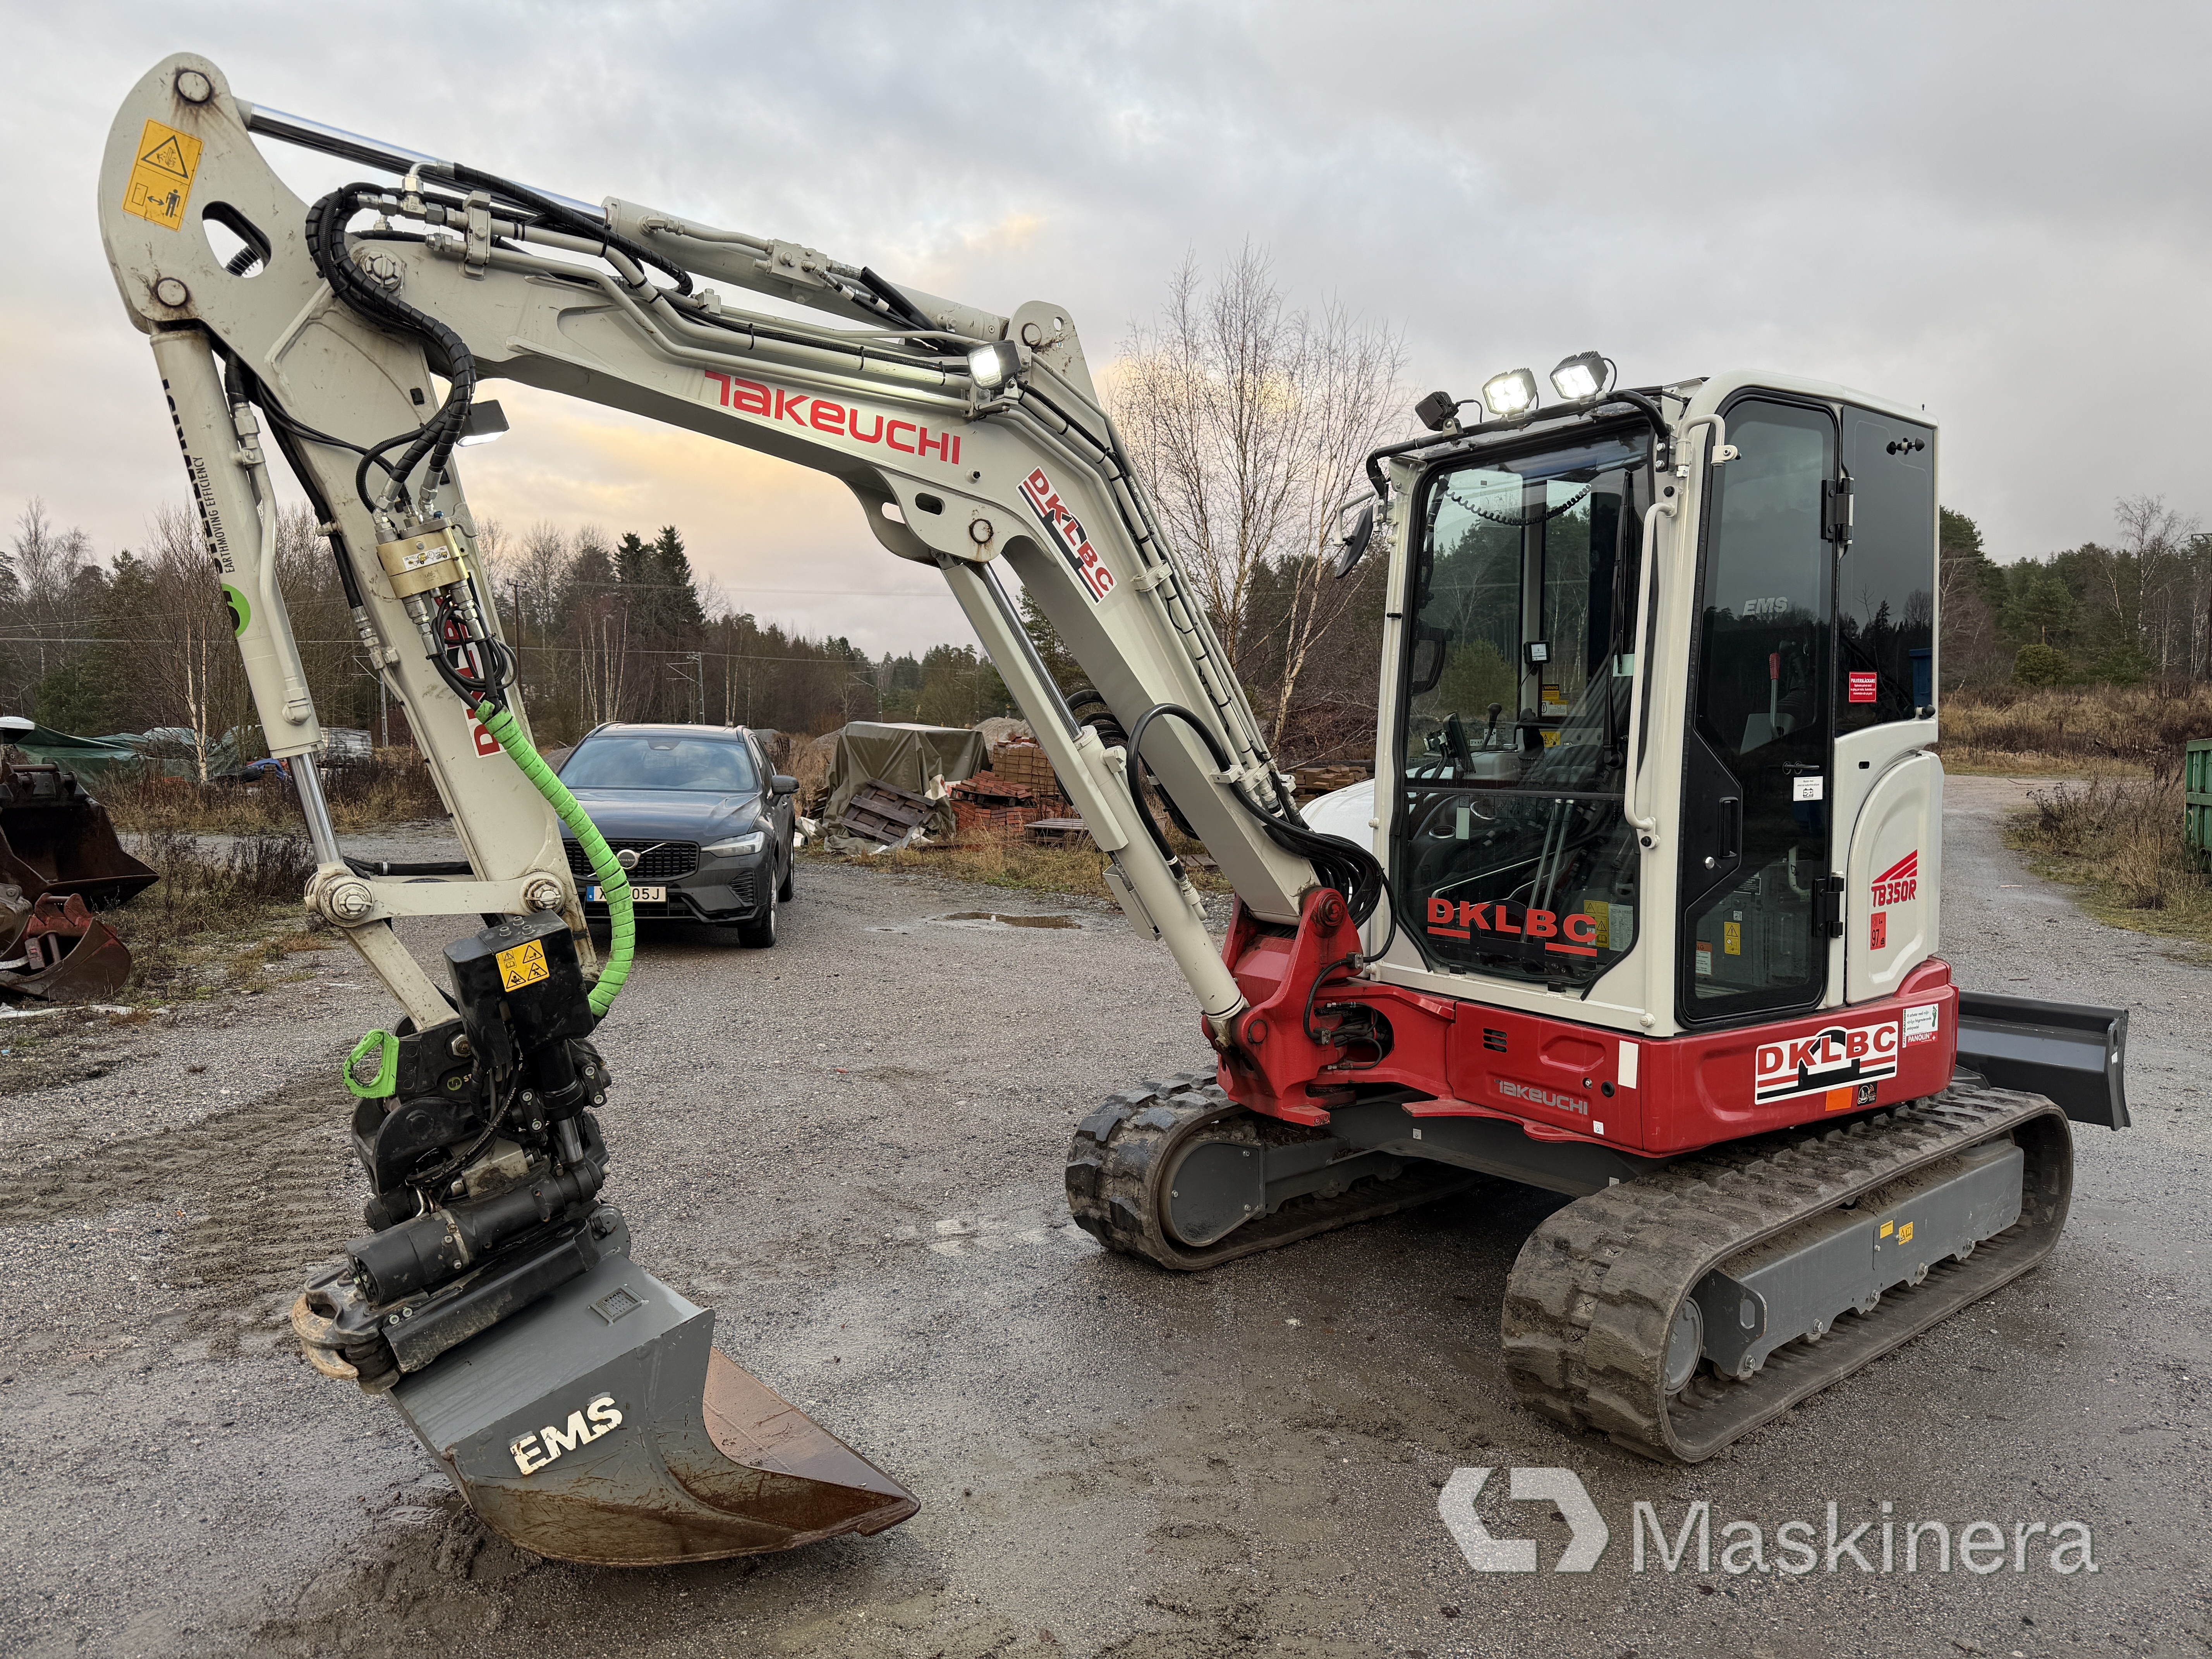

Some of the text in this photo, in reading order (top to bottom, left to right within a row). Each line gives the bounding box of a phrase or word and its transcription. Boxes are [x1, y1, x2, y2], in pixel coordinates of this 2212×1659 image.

[192, 457, 215, 507] EFFICIENCY
[209, 510, 235, 574] EARTHMOVING
[1028, 468, 1114, 592] DKLBC
[1743, 596, 1788, 615] EMS
[1871, 879, 1917, 907] TB350R
[1427, 897, 1597, 943] DKLBC
[1872, 929, 1880, 946] 97
[1757, 1026, 1896, 1075] DKLBC
[1908, 1032, 1930, 1042] PANOLIN
[510, 1396, 623, 1475] EMS
